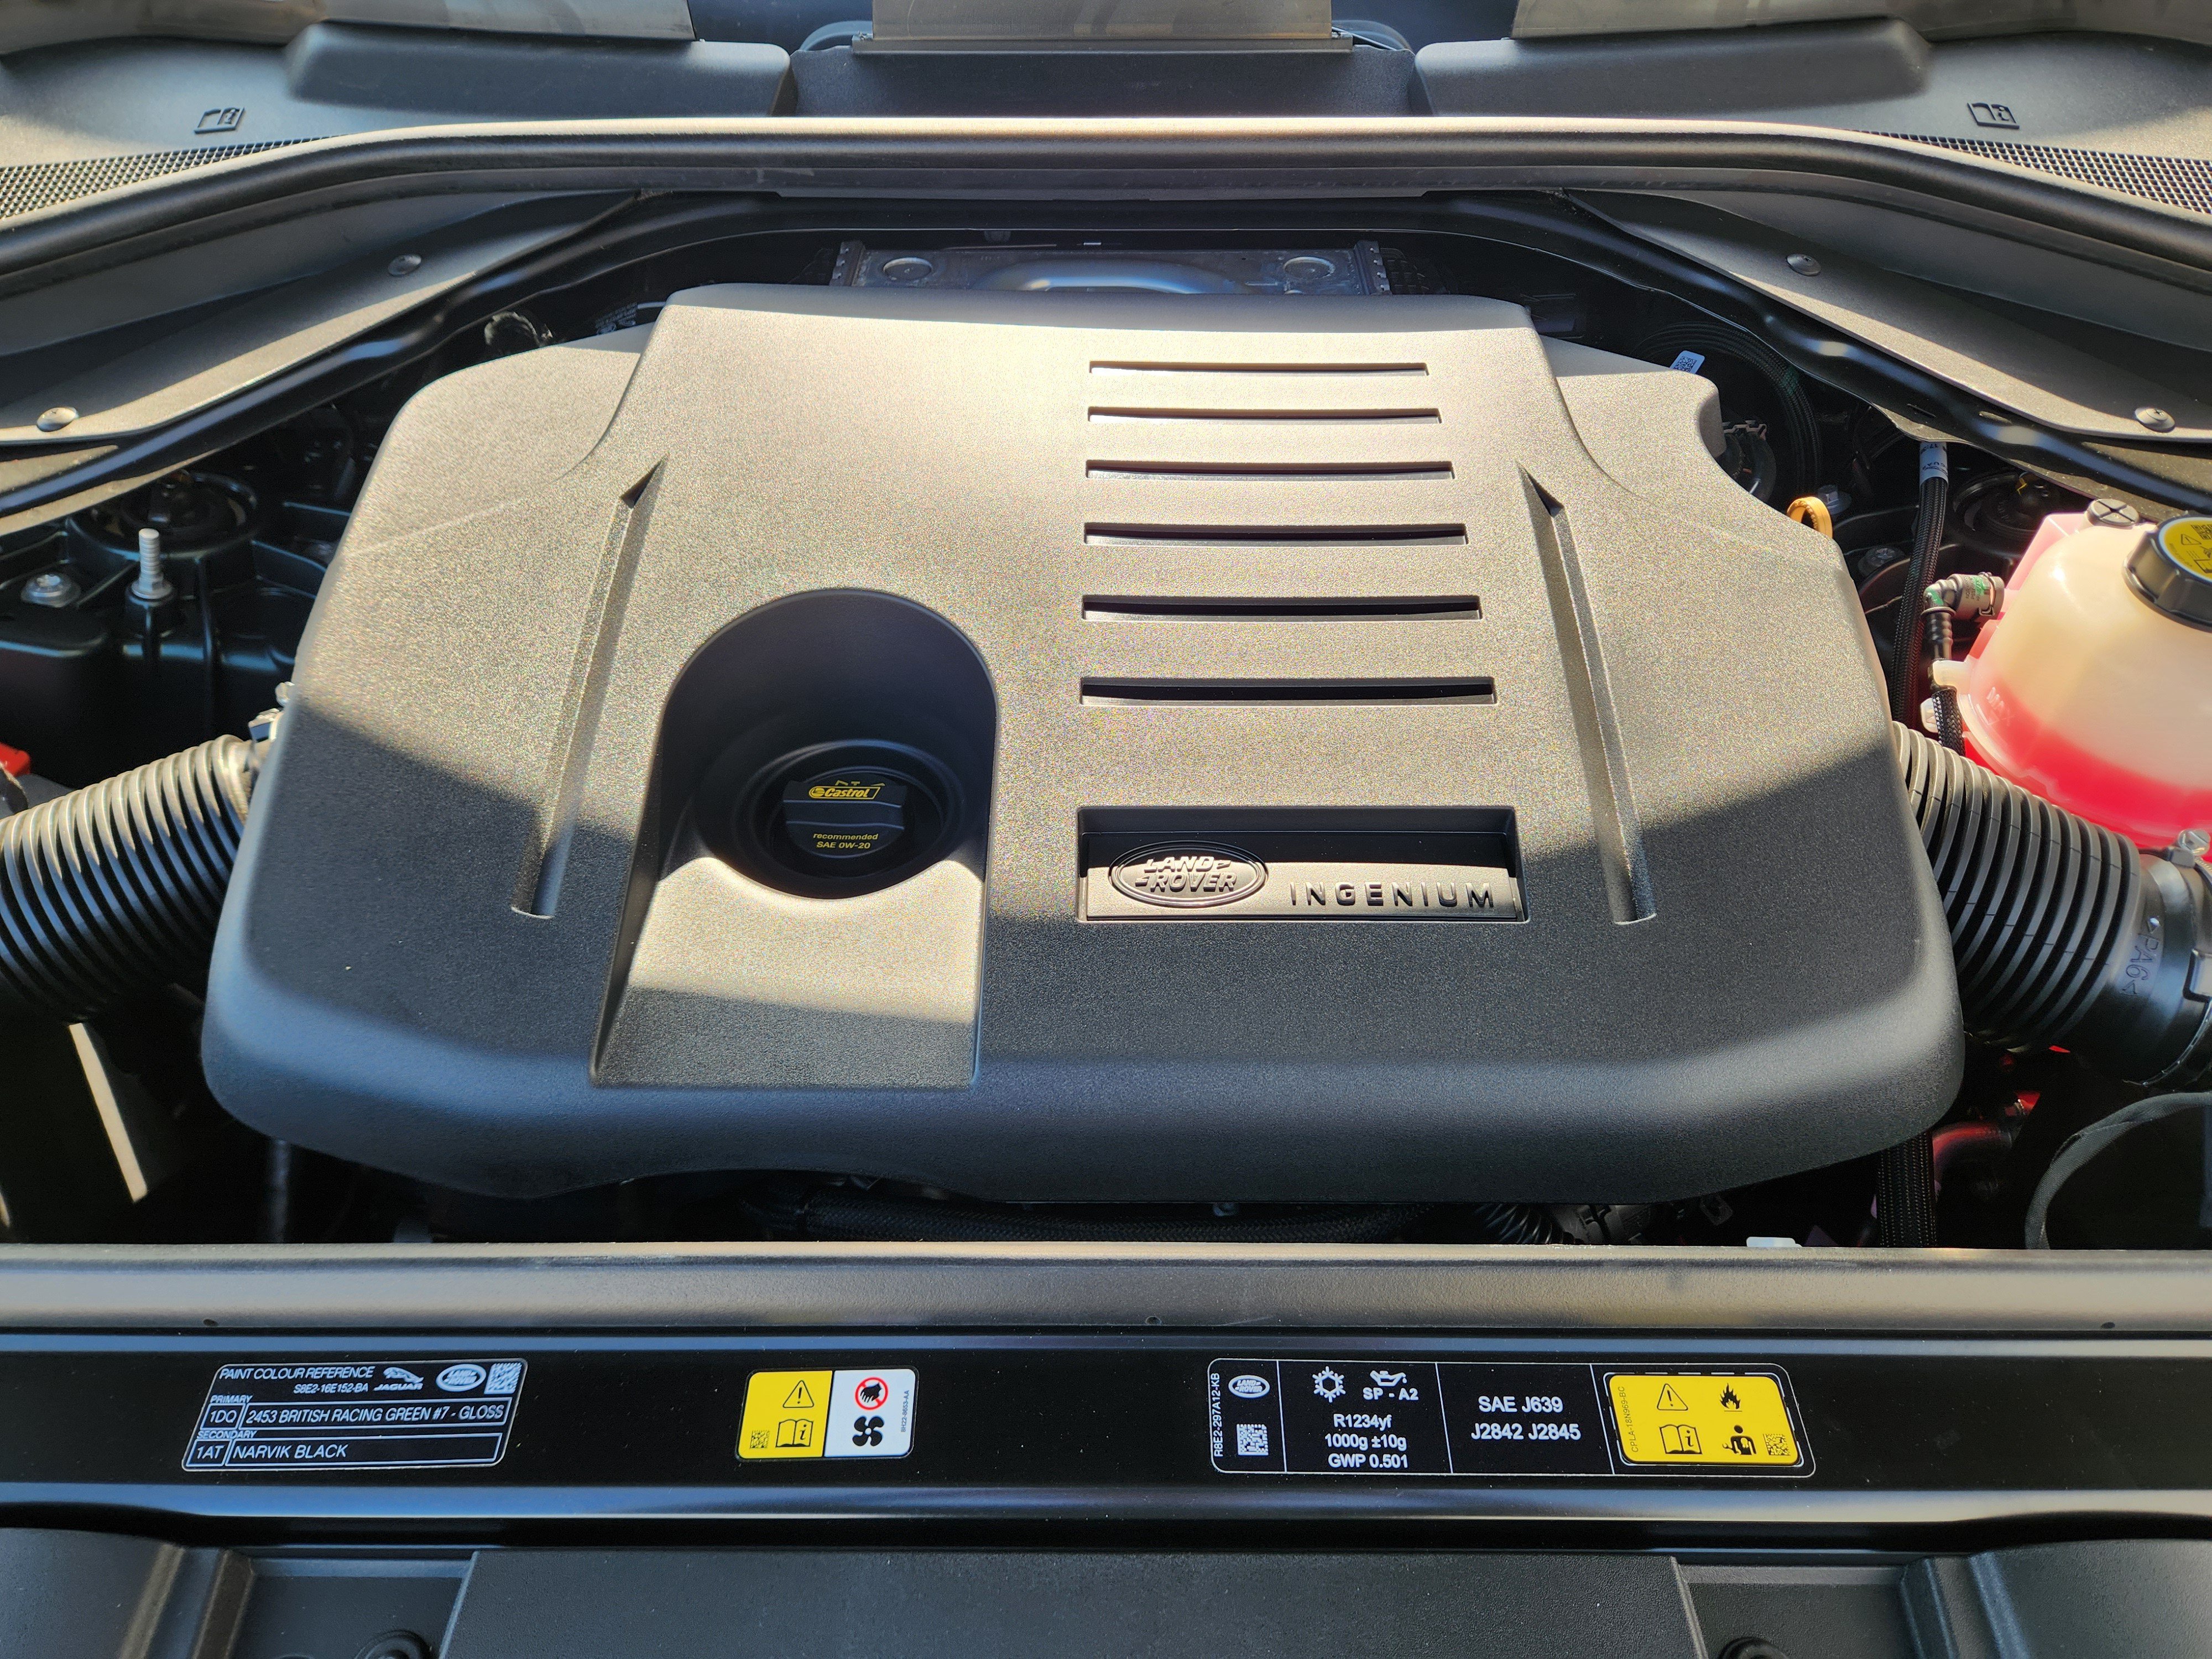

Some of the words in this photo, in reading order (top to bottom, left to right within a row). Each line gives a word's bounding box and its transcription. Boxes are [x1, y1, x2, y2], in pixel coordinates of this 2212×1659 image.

[824, 788, 870, 797] Castrol
[1144, 855, 1214, 872] LAND
[1149, 872, 1237, 892] ROVER
[1289, 880, 1496, 907] INGENIUM
[219, 1368, 253, 1379] PAINT
[253, 1368, 305, 1379] COLOUR
[305, 1366, 375, 1379] REFERENCE
[373, 1383, 423, 1391] JAGUAR
[1363, 1387, 1383, 1400] SP
[1399, 1388, 1419, 1401] A2
[210, 1395, 253, 1404] PRIMARY
[1478, 1396, 1516, 1413] SAE
[1521, 1396, 1564, 1413] J639
[210, 1410, 238, 1423] 1DQ
[246, 1410, 278, 1423] 2453
[279, 1409, 330, 1423] BRITISH
[331, 1407, 383, 1422] RACING
[385, 1406, 431, 1421] GREEN
[432, 1406, 450, 1420] #7
[458, 1405, 504, 1420] GLOSS
[1211, 1373, 1223, 1457] R8E2-297A12-KB
[1333, 1413, 1392, 1431] R1234yf
[1618, 1386, 1639, 1452] CPLA-18N969-BC
[196, 1430, 258, 1439] SECONDARY
[1471, 1423, 1524, 1441] J2842
[1528, 1423, 1582, 1441] J2845
[1325, 1433, 1369, 1451] 1000g
[1371, 1434, 1407, 1451] ±10g
[197, 1445, 225, 1459] 1AT
[233, 1444, 291, 1459] NARVIK
[294, 1444, 349, 1458] BLACK
[1328, 1453, 1366, 1468] GWP
[1369, 1453, 1408, 1468] 0.501
